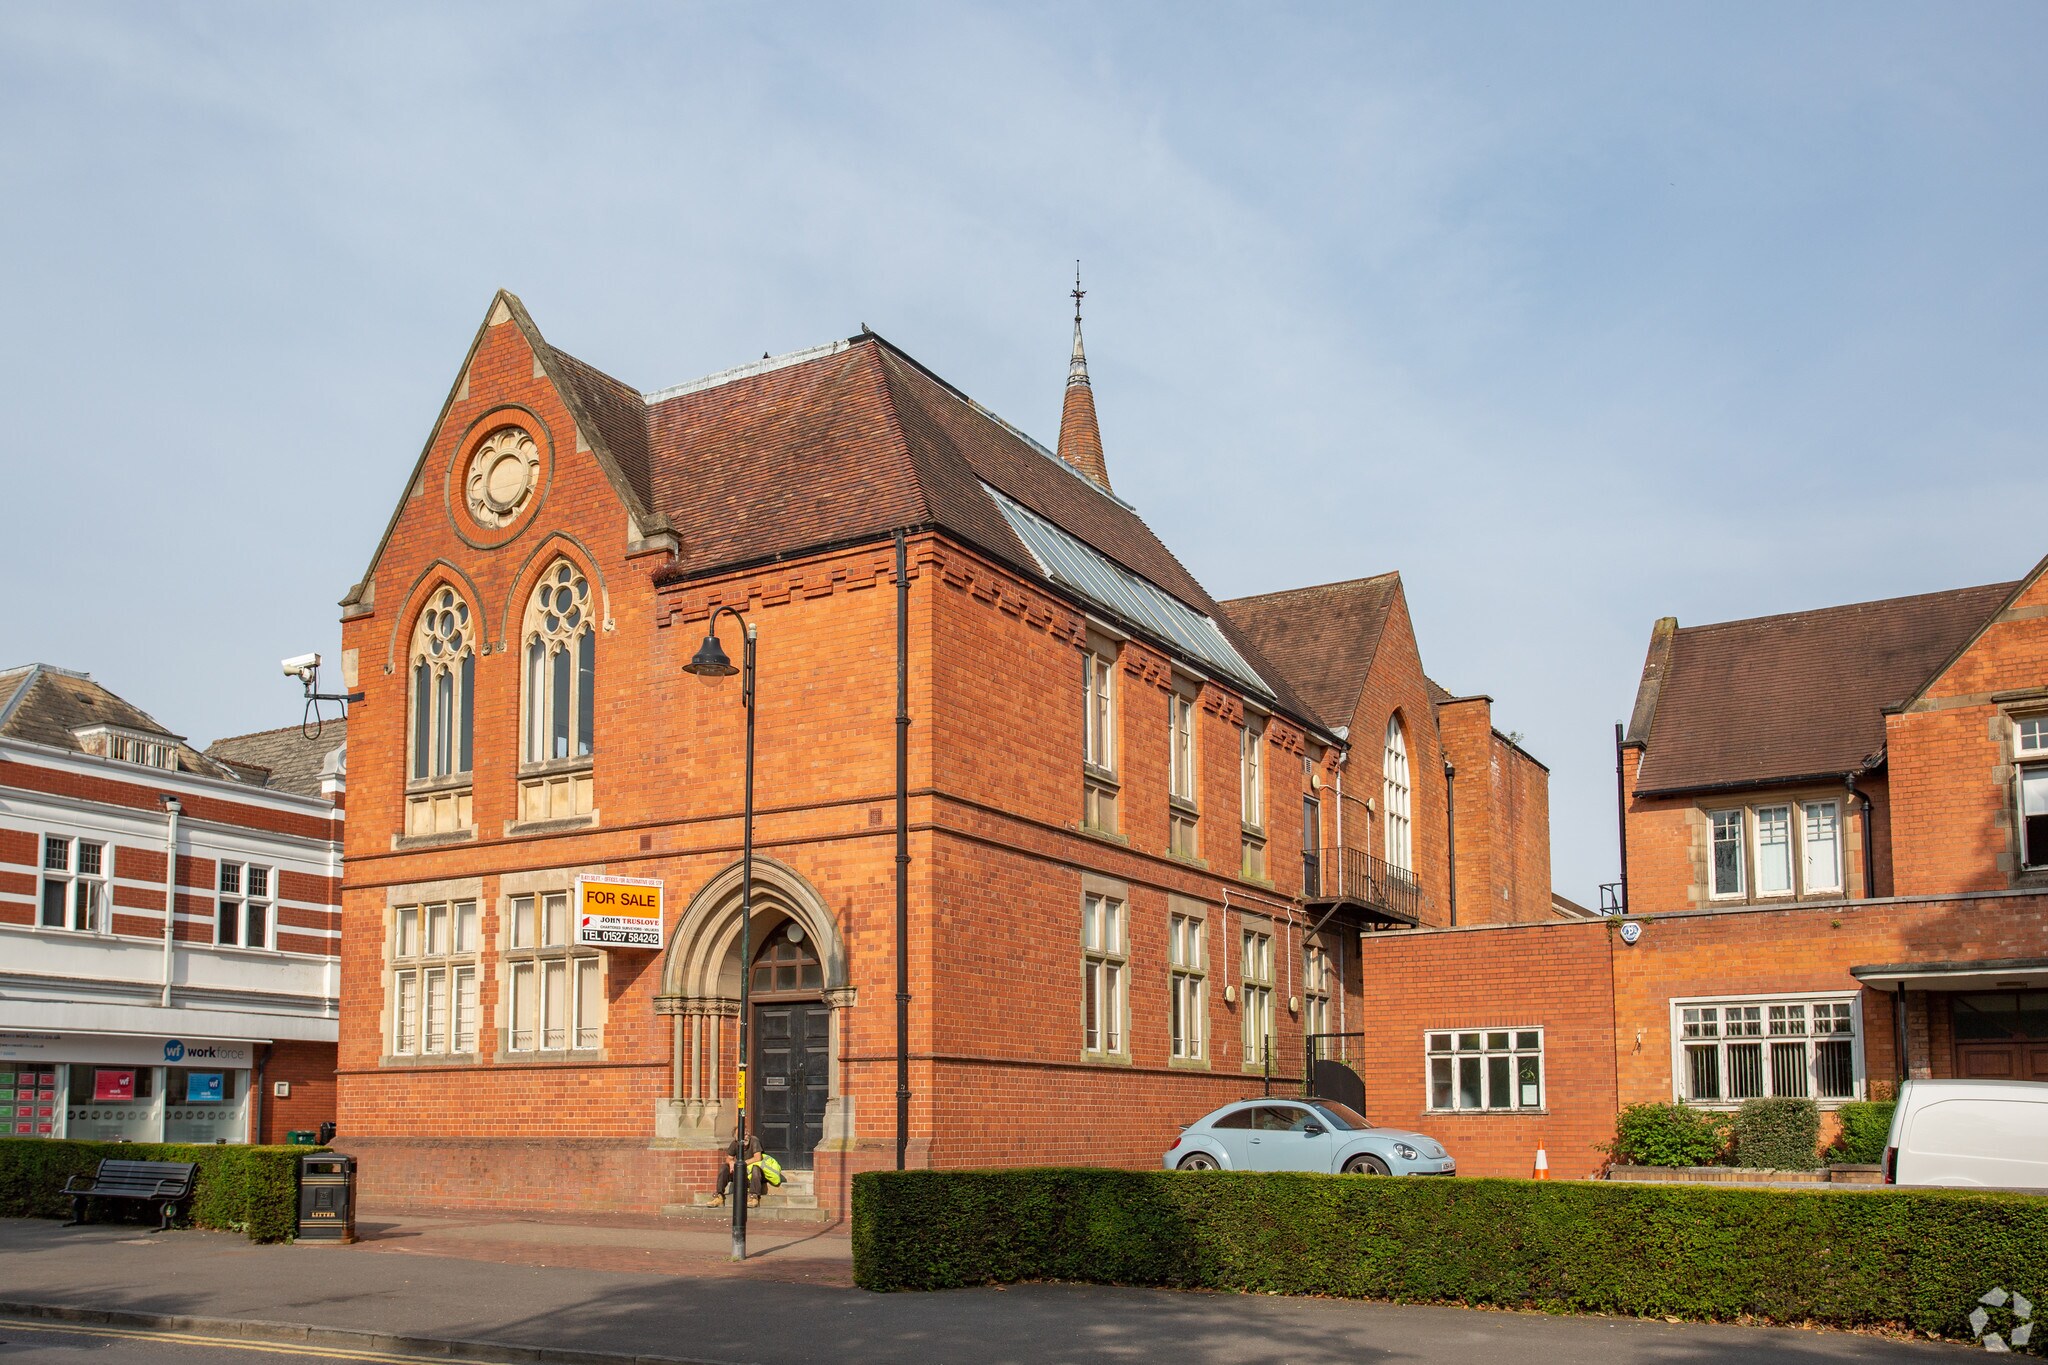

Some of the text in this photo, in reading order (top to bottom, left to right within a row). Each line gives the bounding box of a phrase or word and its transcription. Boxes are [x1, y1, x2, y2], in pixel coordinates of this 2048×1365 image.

[587, 891, 655, 907] FOR SALE
[622, 918, 659, 926] TRUSLOVE
[583, 930, 658, 943] TEL 01527 584242
[166, 1045, 244, 1059] wf workforce
[119, 1077, 130, 1085] wf
